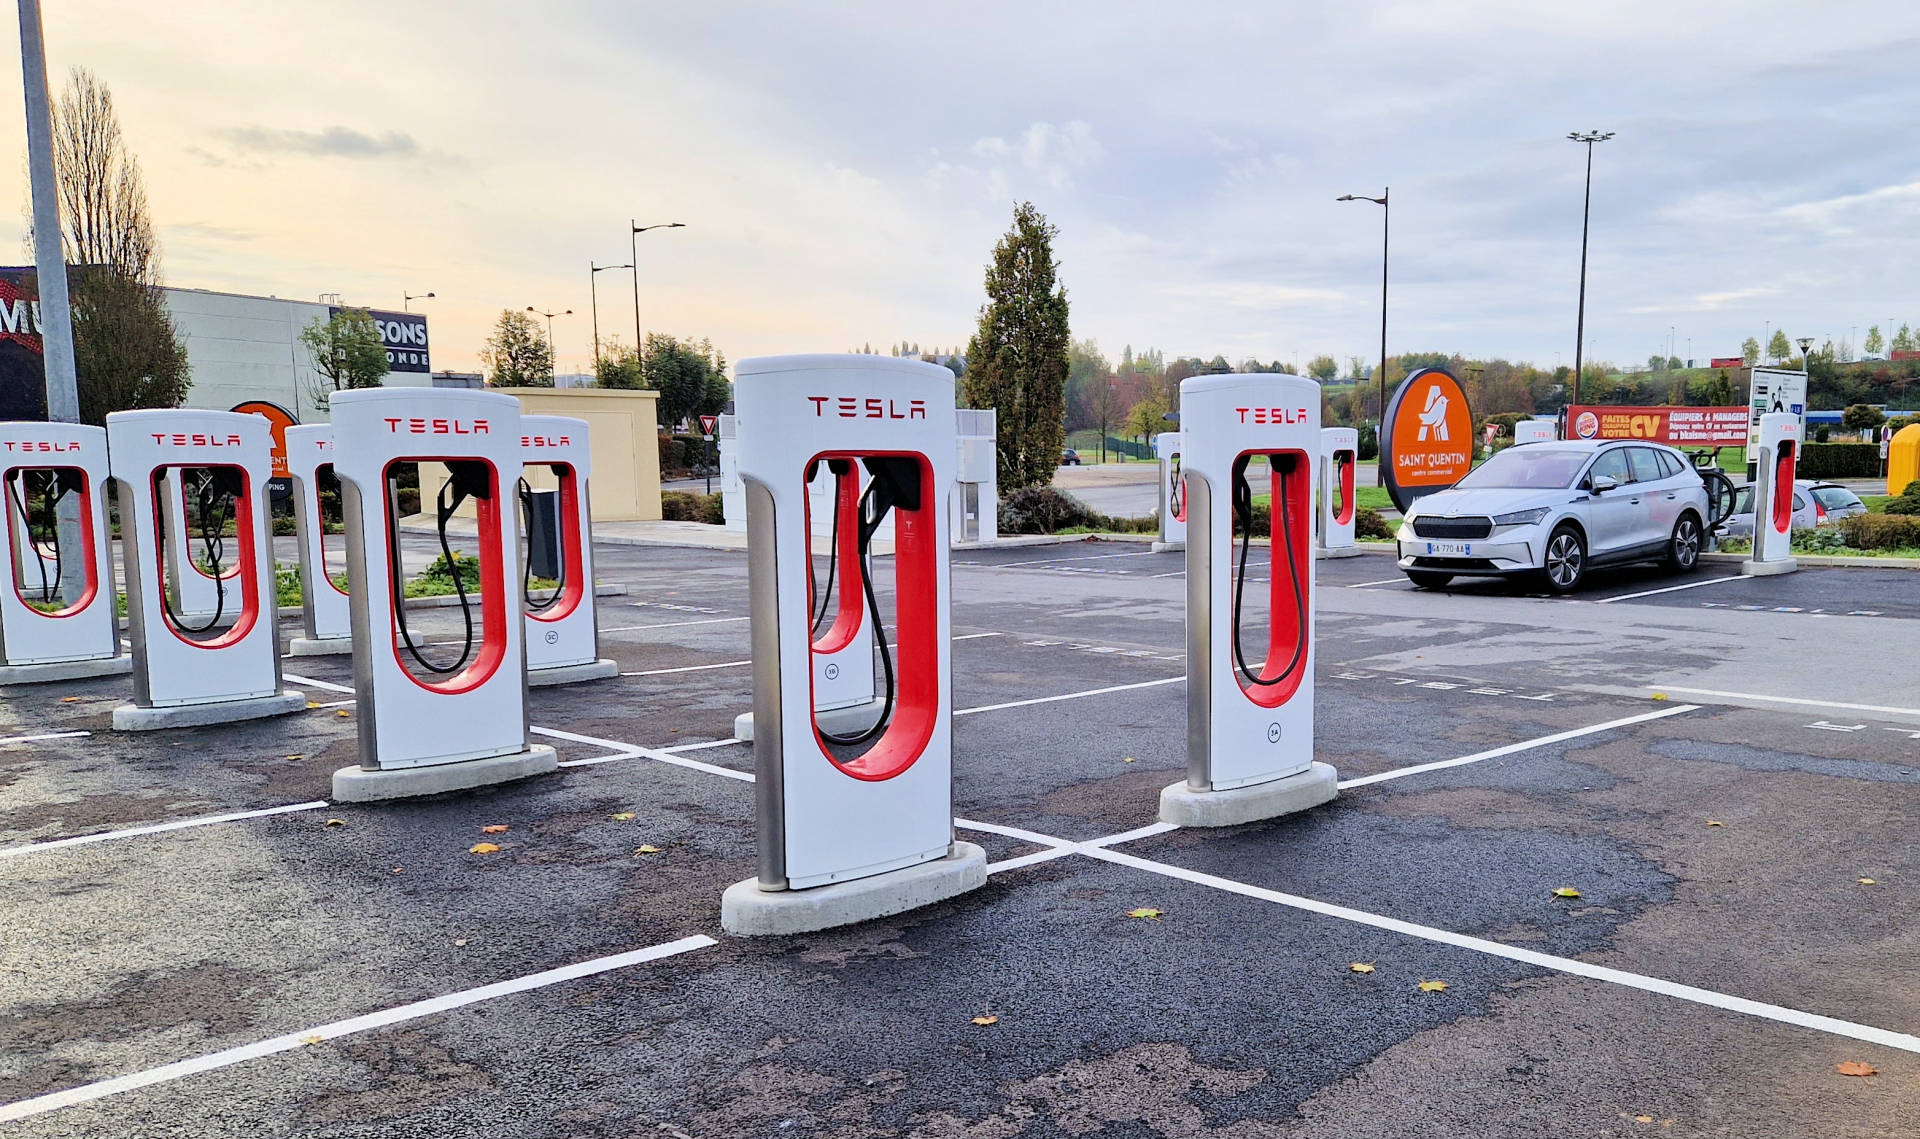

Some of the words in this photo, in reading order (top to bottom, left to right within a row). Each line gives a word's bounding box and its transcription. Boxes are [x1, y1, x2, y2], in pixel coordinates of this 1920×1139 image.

[374, 319, 427, 346] SONS
[386, 351, 429, 366] ONDE
[807, 396, 926, 420] TESLA
[1235, 408, 1307, 424] TESLA
[1602, 414, 1630, 423] FAITES
[1712, 412, 1748, 422] MANAGERS
[384, 418, 489, 434] TESLA
[1602, 429, 1630, 438] VOTRE
[1630, 415, 1661, 438] CV
[3, 441, 81, 452] TESLA
[151, 434, 241, 446] TESLA
[521, 436, 570, 446] ESLA
[1399, 453, 1426, 467] SAINT
[1428, 452, 1466, 467] QUENTIN
